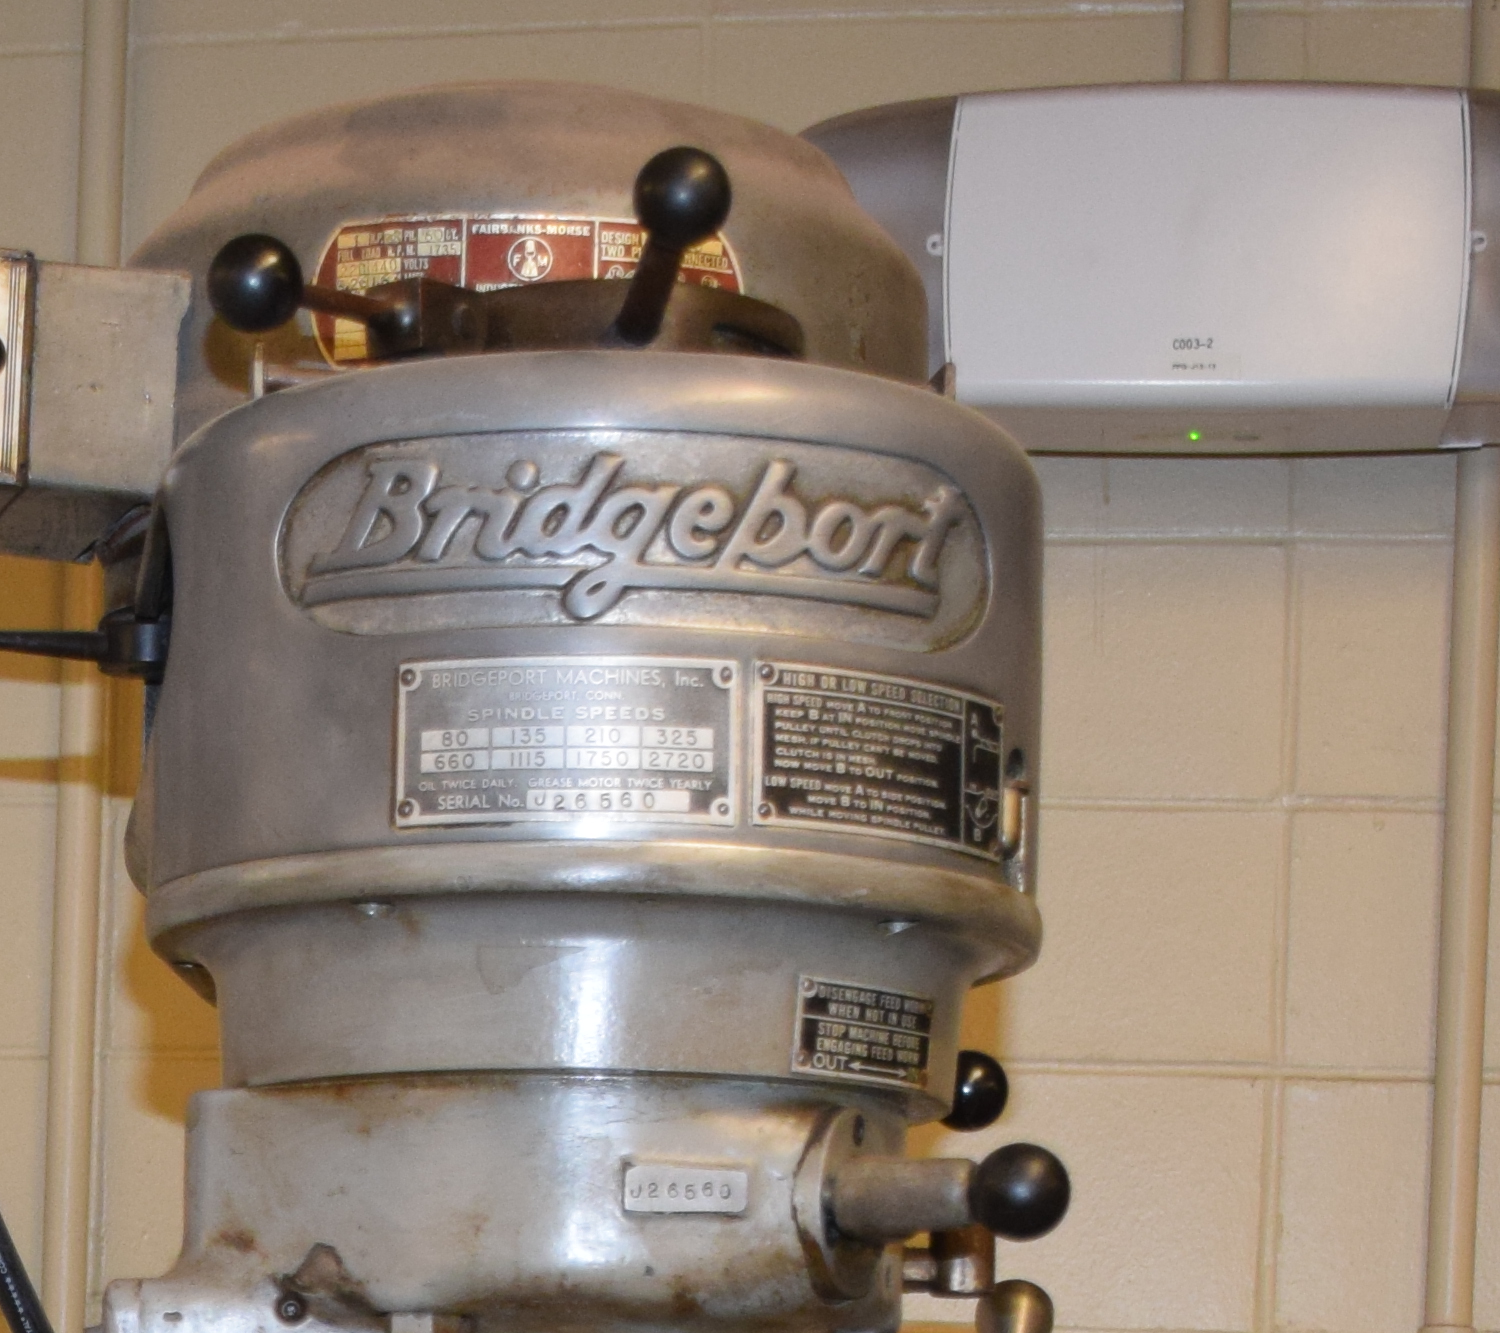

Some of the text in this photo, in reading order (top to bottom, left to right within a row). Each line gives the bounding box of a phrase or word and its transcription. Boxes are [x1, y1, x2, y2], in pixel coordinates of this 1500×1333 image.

[601, 231, 640, 245] DESIGN
[513, 254, 521, 266] F
[601, 245, 625, 258] TWO
[404, 258, 429, 271] VOLTS
[1172, 338, 1213, 350] C003-2
[302, 450, 966, 622] Bridgeport
[432, 668, 704, 689] BRIDGEPORT MACHINES, Inc.
[585, 690, 625, 701] CONN.
[782, 671, 961, 712] HIGH OR LOW SPEED SELECTION
[468, 706, 665, 721] SPINDLE SPEEDS
[767, 692, 952, 729] HIGH SPEED MOVE A TO FRONT POSITION
[774, 721, 816, 733] PULLEY
[819, 725, 849, 738] UNTIL
[852, 728, 890, 743] CLUTCH
[893, 736, 922, 748] DROPS
[775, 708, 961, 743] KEEP B AT IN POSITION MOVE SPINDLE
[442, 728, 698, 746] 80 135 210 325
[775, 747, 820, 760] CLUTCH
[822, 751, 833, 760] IS
[836, 752, 846, 762] IN
[822, 739, 860, 751] PULLEY
[893, 749, 905, 758] BE
[434, 751, 705, 770] 660 1115 1750 2720
[773, 759, 800, 770] NOW
[804, 761, 833, 773] MOVE
[836, 762, 846, 774] B
[849, 766, 862, 776] TO
[865, 767, 894, 780] OUT
[419, 778, 712, 792] OIL TWICE DAILY. GREASE MOTOR TWICE YEARLY
[764, 775, 787, 787] LOW
[789, 777, 822, 792] SPEED
[824, 783, 852, 795] MOVE
[855, 785, 865, 796] A
[866, 788, 879, 798] TO
[881, 790, 903, 802] SIDE
[438, 795, 490, 810] SERIAL
[499, 794, 525, 808] No.
[807, 795, 837, 807] MOVE
[840, 796, 850, 808] B
[853, 800, 867, 809] TO
[870, 800, 884, 812] IN
[789, 806, 825, 818] WHILE
[828, 811, 868, 823] MOVING
[871, 815, 911, 830] SPINDLE
[818, 986, 901, 1010] DISENGAGE FEED
[828, 1002, 917, 1029] WHEN NOT IN USE
[818, 1022, 921, 1050] STOP MACHINE BEFORE
[817, 1038, 894, 1061] ENGAGING FEED
[813, 1053, 849, 1070] OUT
[630, 1181, 731, 1200] J26560
